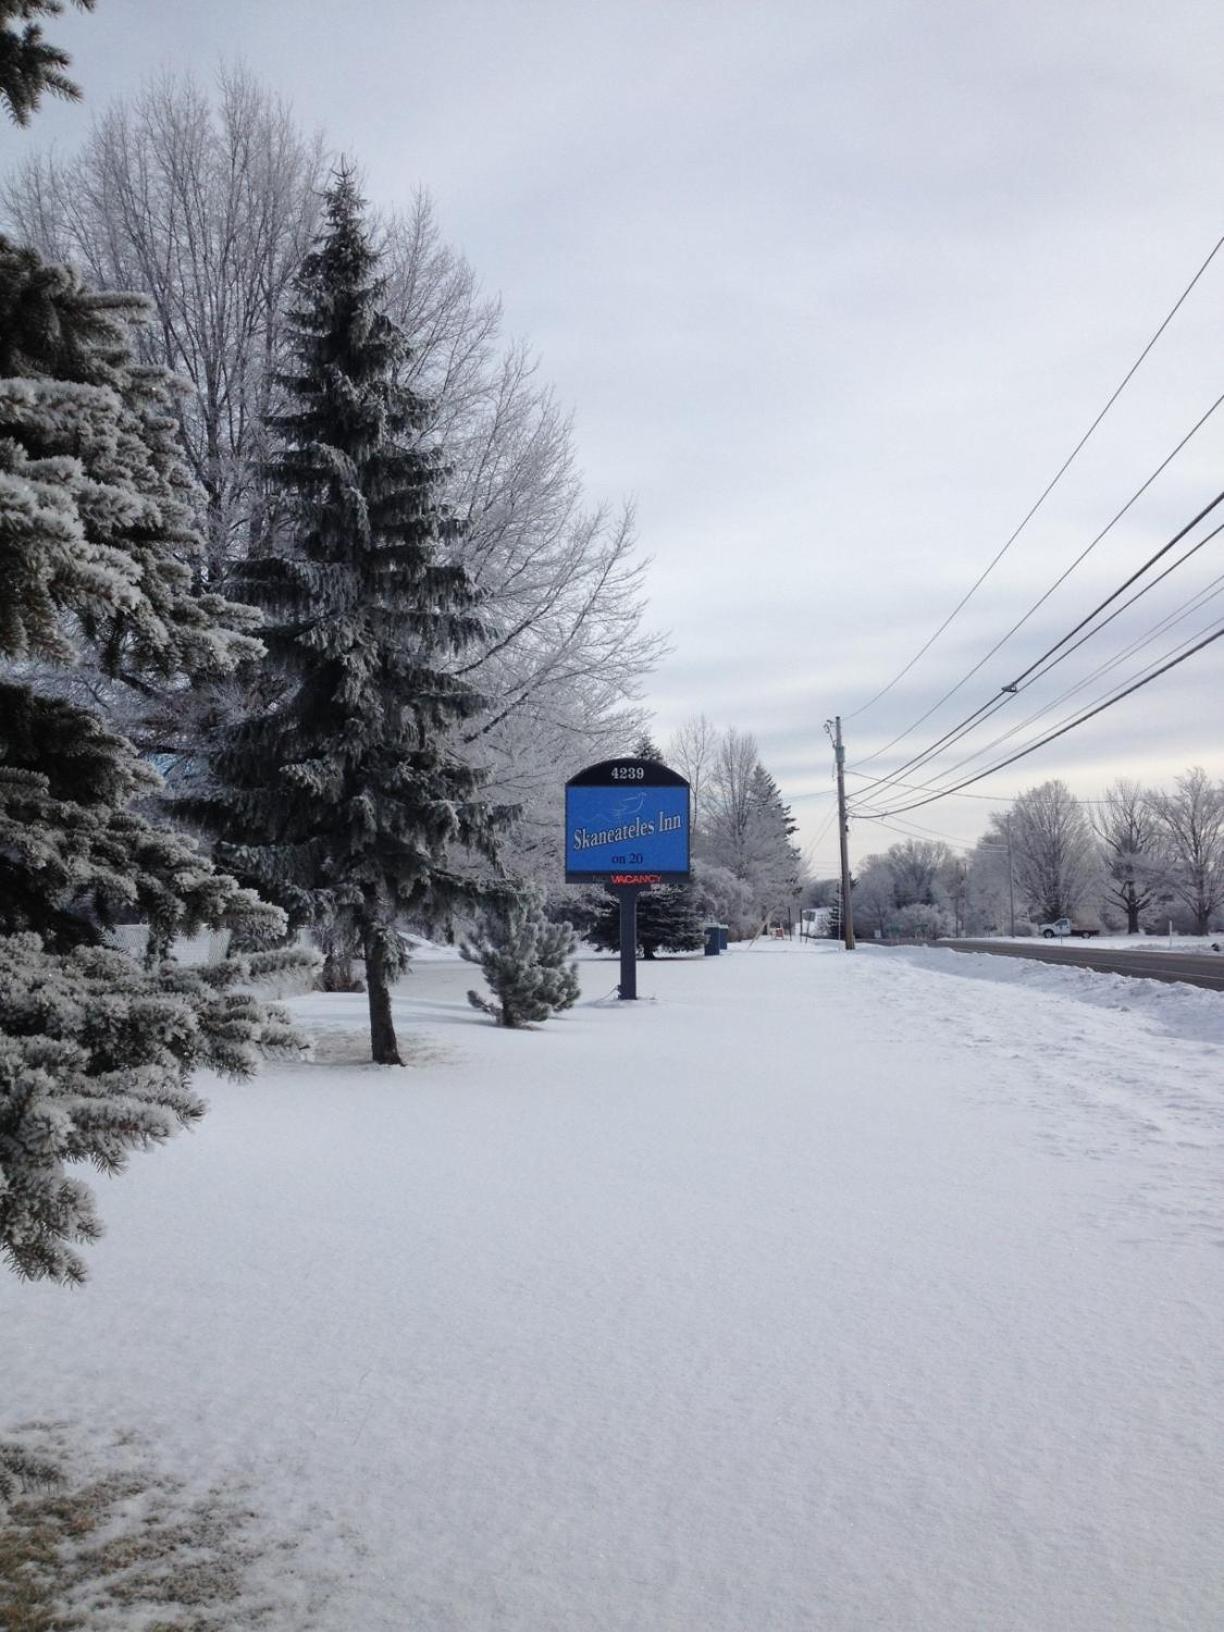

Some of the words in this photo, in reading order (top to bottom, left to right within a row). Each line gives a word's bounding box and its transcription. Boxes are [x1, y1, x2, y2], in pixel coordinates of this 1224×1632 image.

[611, 767, 645, 780] 4239
[573, 816, 655, 850] Skaneateles
[659, 811, 682, 832] Inn
[611, 855, 626, 865] on
[629, 852, 644, 865] 20
[611, 874, 662, 884] VACANCY
